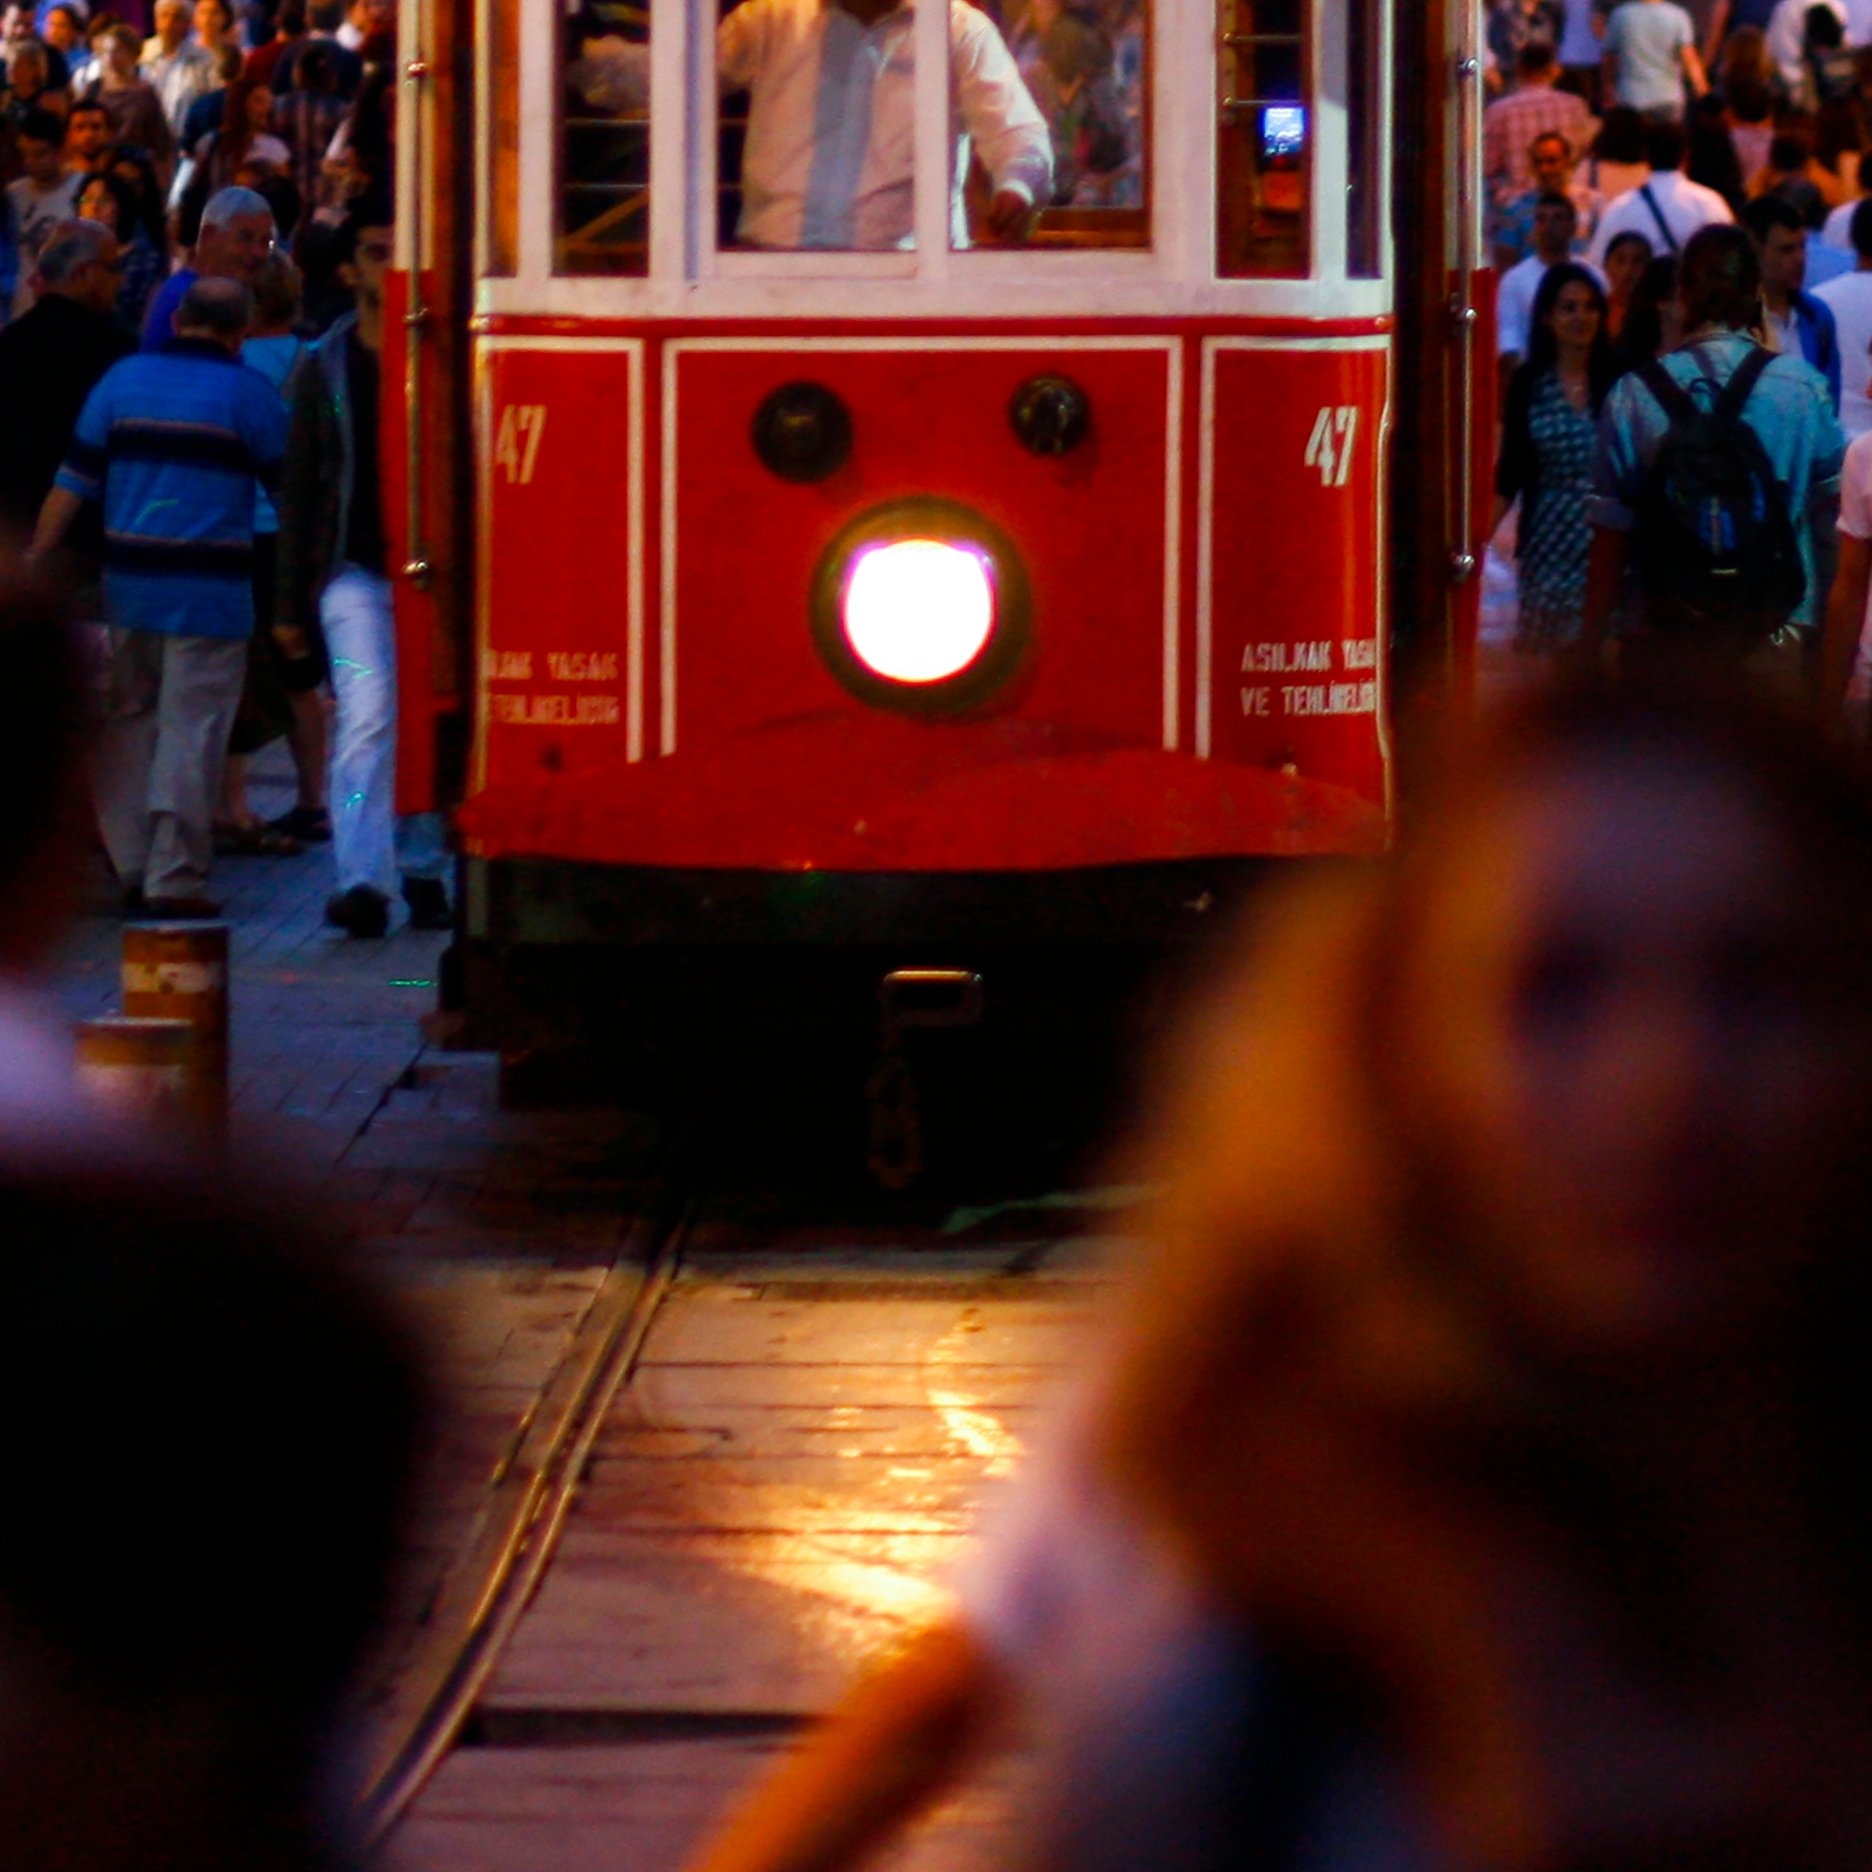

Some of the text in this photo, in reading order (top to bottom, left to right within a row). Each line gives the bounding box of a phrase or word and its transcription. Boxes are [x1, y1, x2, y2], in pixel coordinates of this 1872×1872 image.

[495, 404, 548, 484] 47
[1303, 405, 1358, 487] 47
[1240, 686, 1271, 717] VE
